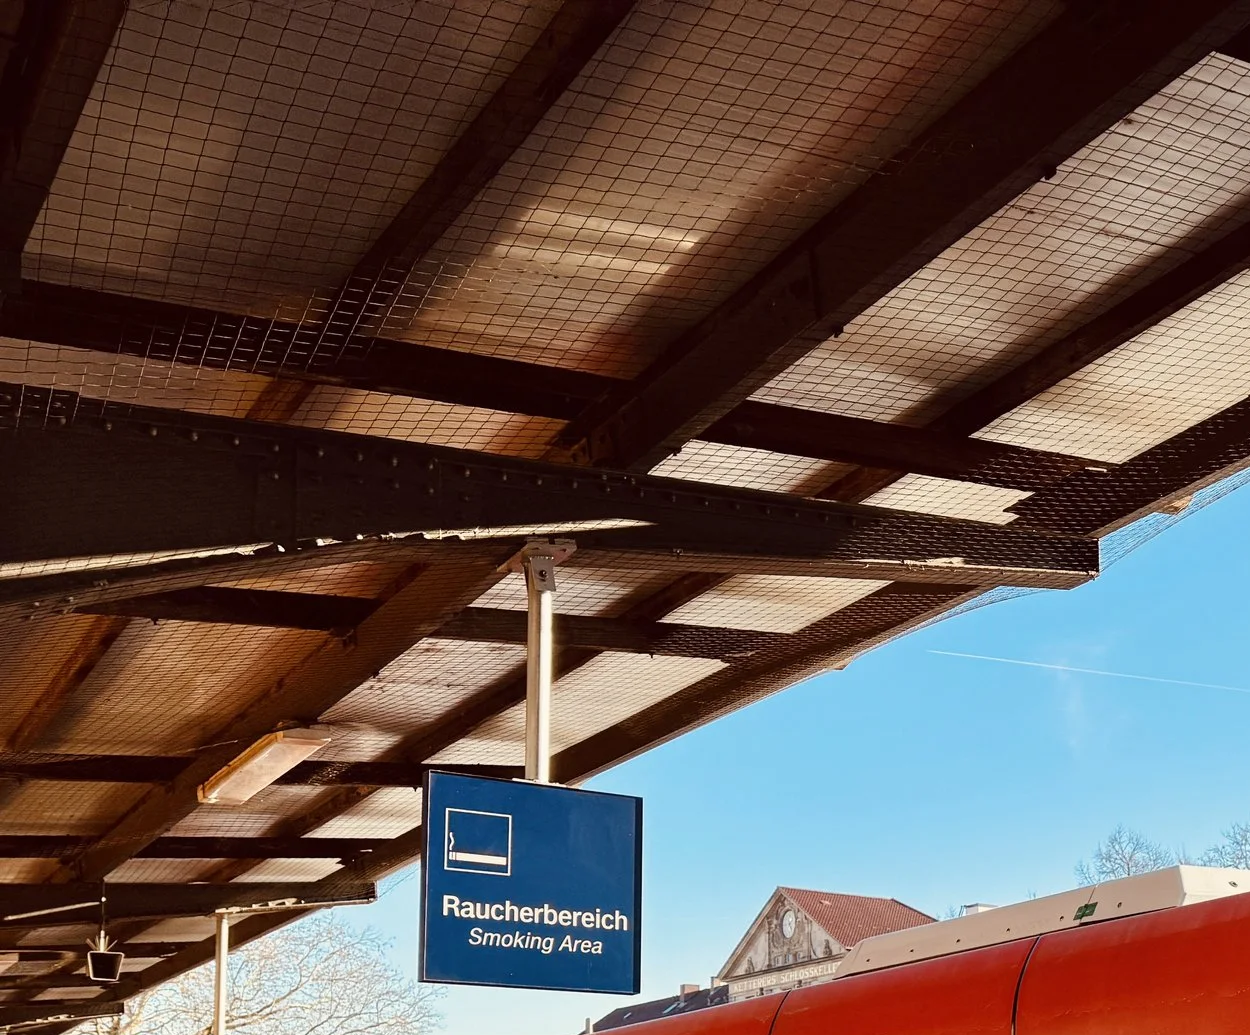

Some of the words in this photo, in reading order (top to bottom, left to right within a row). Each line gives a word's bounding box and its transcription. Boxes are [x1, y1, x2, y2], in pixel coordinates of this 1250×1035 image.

[442, 894, 629, 931] Raucherbereich
[468, 927, 554, 955] Smoking
[558, 934, 603, 954] Area
